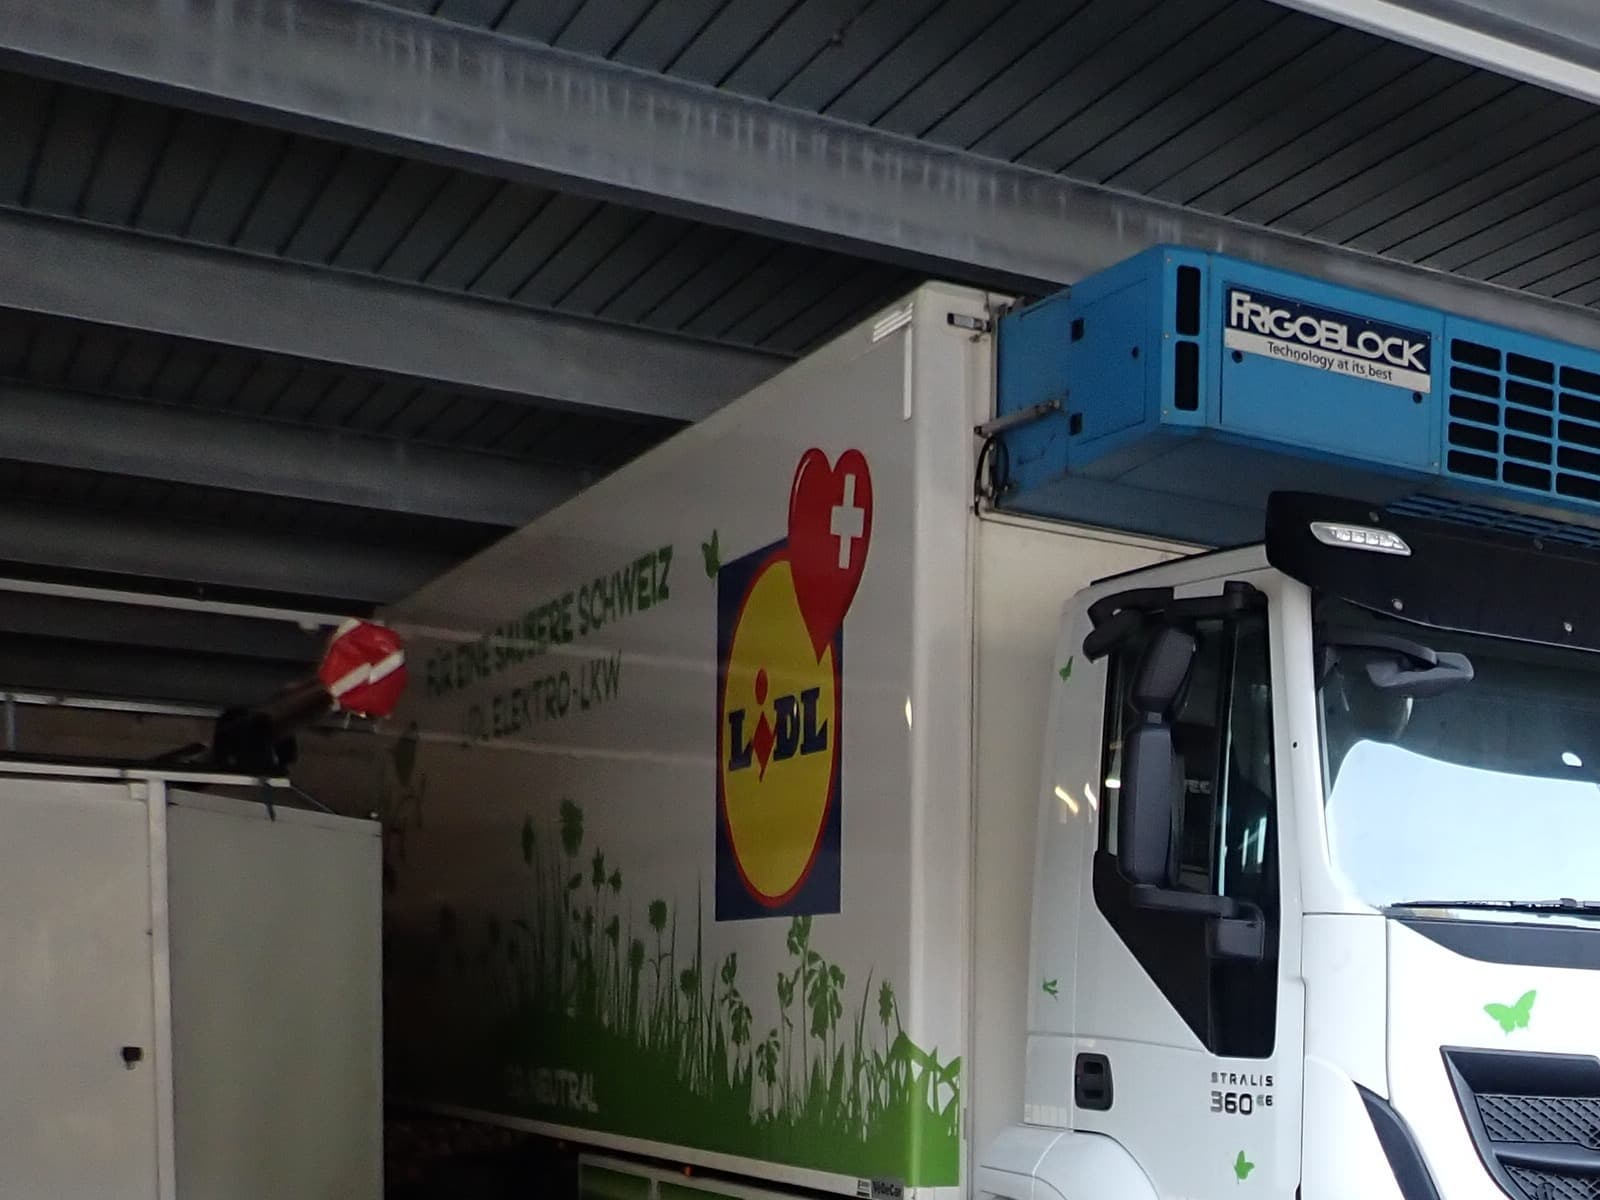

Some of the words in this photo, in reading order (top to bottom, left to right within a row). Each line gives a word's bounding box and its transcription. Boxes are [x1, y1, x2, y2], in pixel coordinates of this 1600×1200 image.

[1230, 291, 1426, 372] FRIGOBLOCK
[1268, 341, 1335, 369] Technology
[1337, 359, 1349, 372] at
[1351, 360, 1366, 376] its
[1368, 365, 1393, 382] best
[577, 544, 674, 637] SCHWEIZ
[1211, 1071, 1273, 1087] STRALIS
[1210, 1090, 1252, 1115] 360
